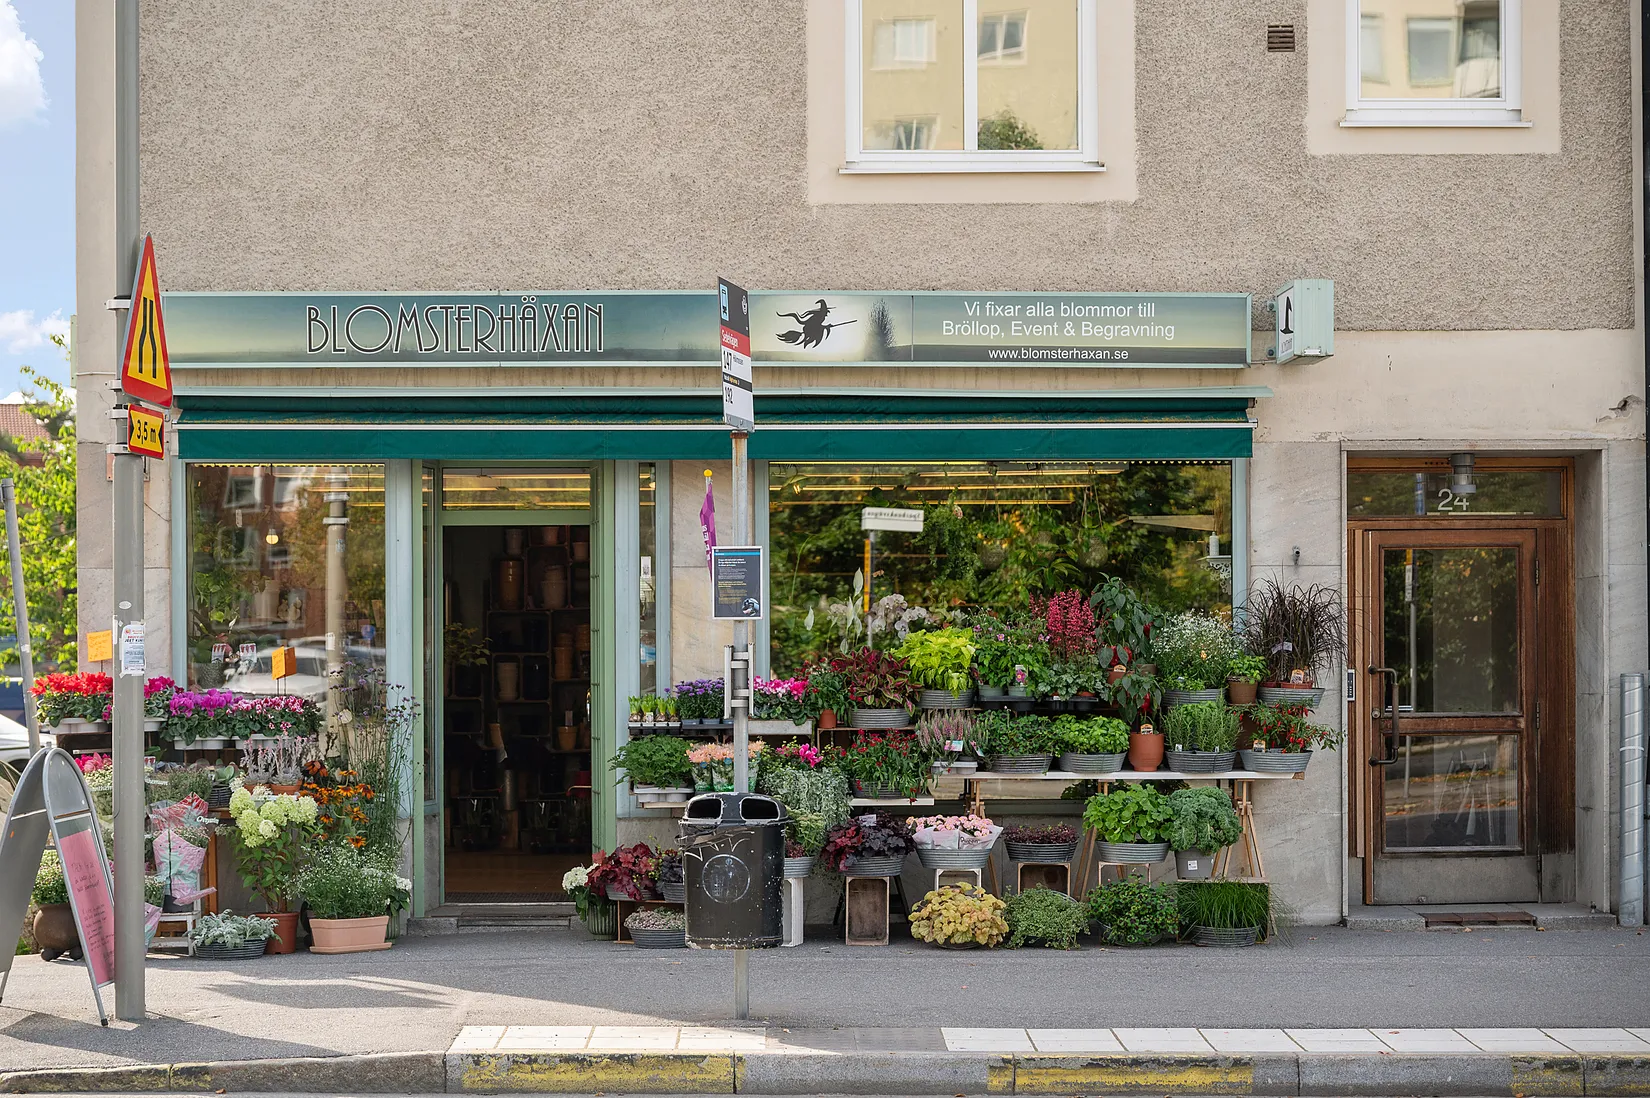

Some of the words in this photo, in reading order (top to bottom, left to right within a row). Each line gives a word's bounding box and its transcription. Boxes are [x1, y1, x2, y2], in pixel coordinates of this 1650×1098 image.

[964, 301, 980, 316] Vi
[985, 301, 1021, 317] fixar
[1026, 302, 1055, 317] alla
[1060, 302, 1133, 317] blommor
[1137, 302, 1155, 317] till
[306, 296, 604, 353] BLOMSTERHÄXAN
[942, 320, 1005, 339] Bröllop,
[1011, 321, 1059, 337] Event
[1063, 322, 1076, 337] &
[1081, 322, 1175, 340] Begravning
[988, 347, 1129, 360] www.blomsterhaxan.se
[137, 419, 148, 444] 3,5
[150, 427, 157, 443] m
[1438, 488, 1470, 511] 24
